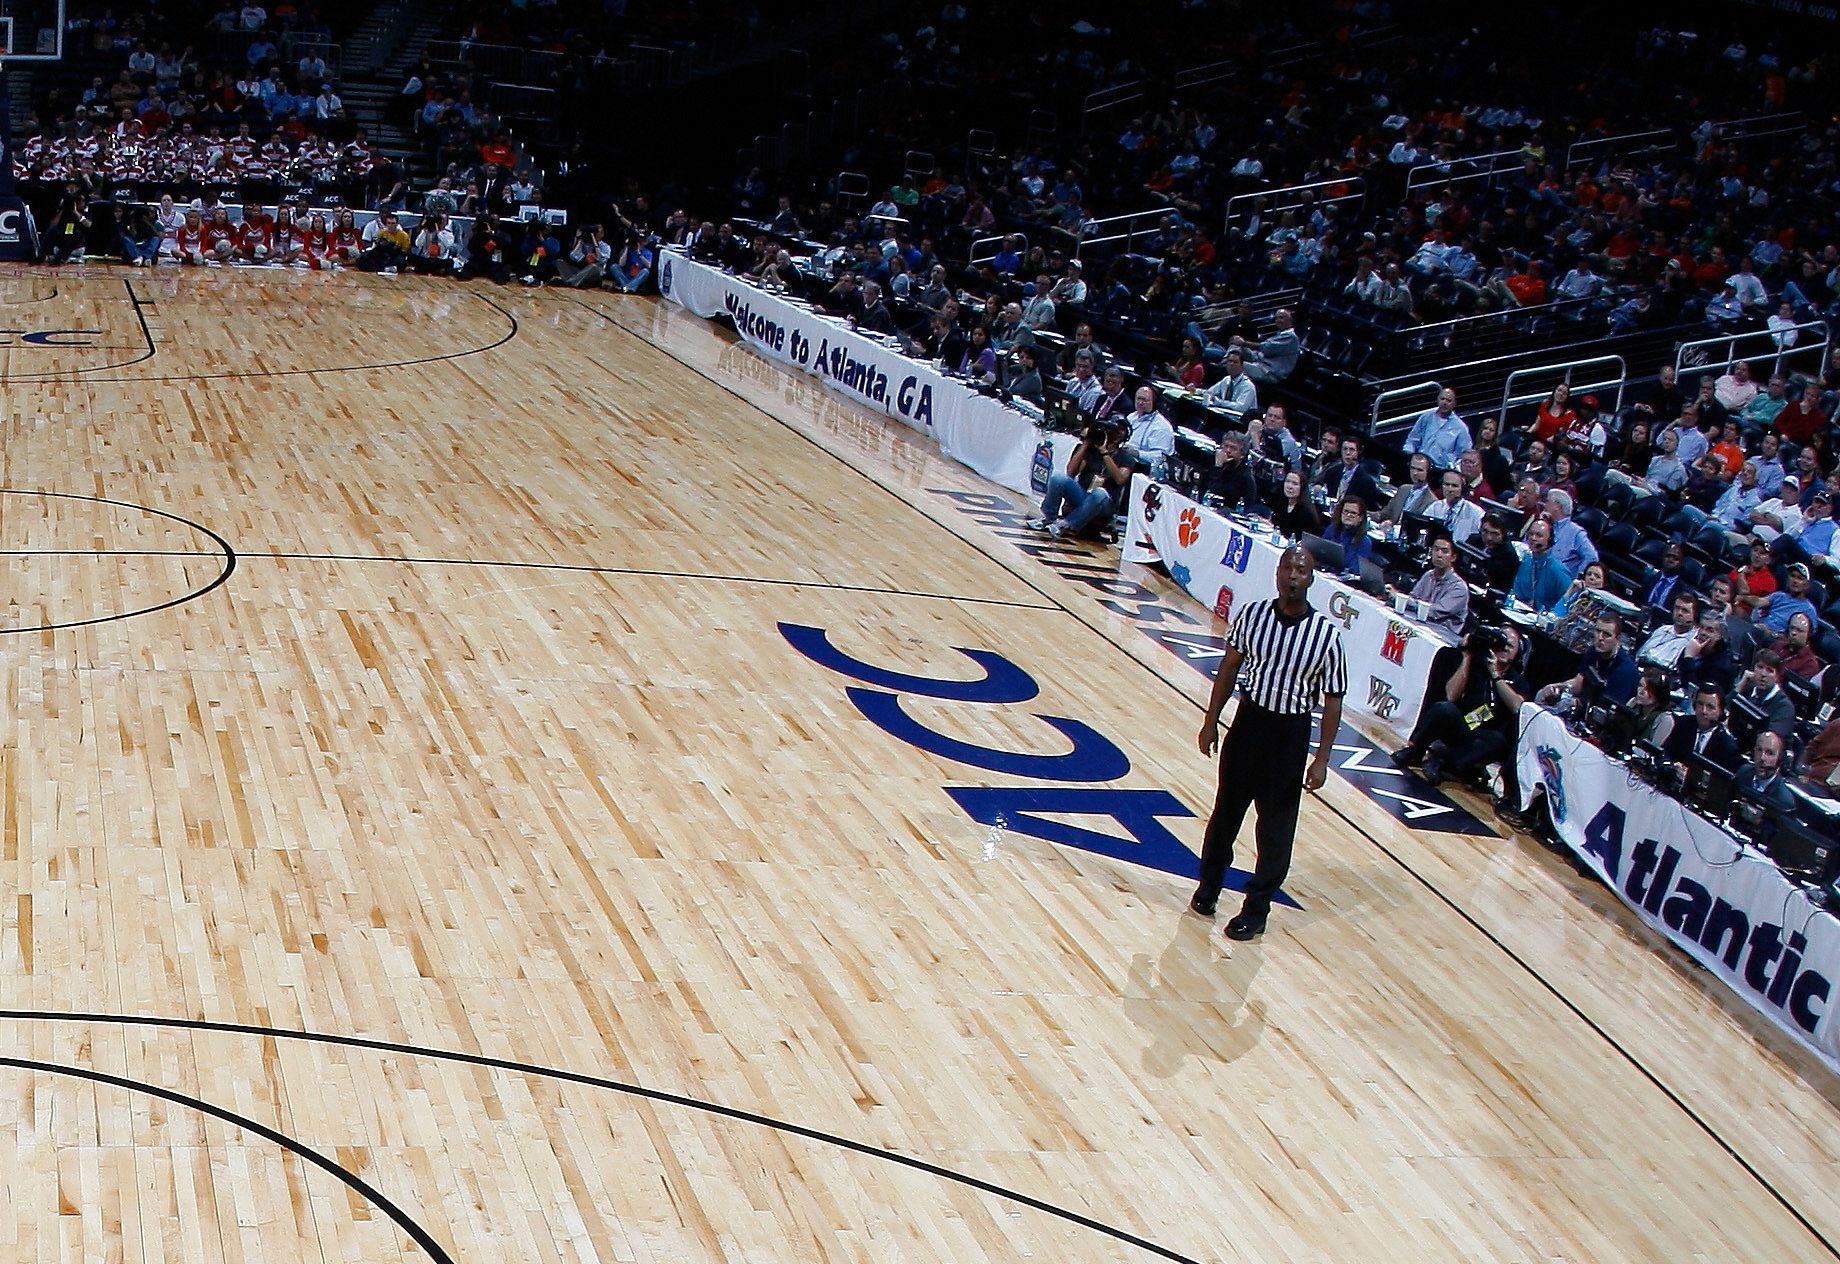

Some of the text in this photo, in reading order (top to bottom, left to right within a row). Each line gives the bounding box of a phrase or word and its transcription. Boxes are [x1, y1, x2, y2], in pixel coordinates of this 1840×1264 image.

[725, 290, 934, 426] Welcome to Atlanta, GA
[925, 488, 1201, 625] PHILIPS
[776, 620, 1306, 911] ACC
[1581, 801, 1831, 1034] Atlantic
